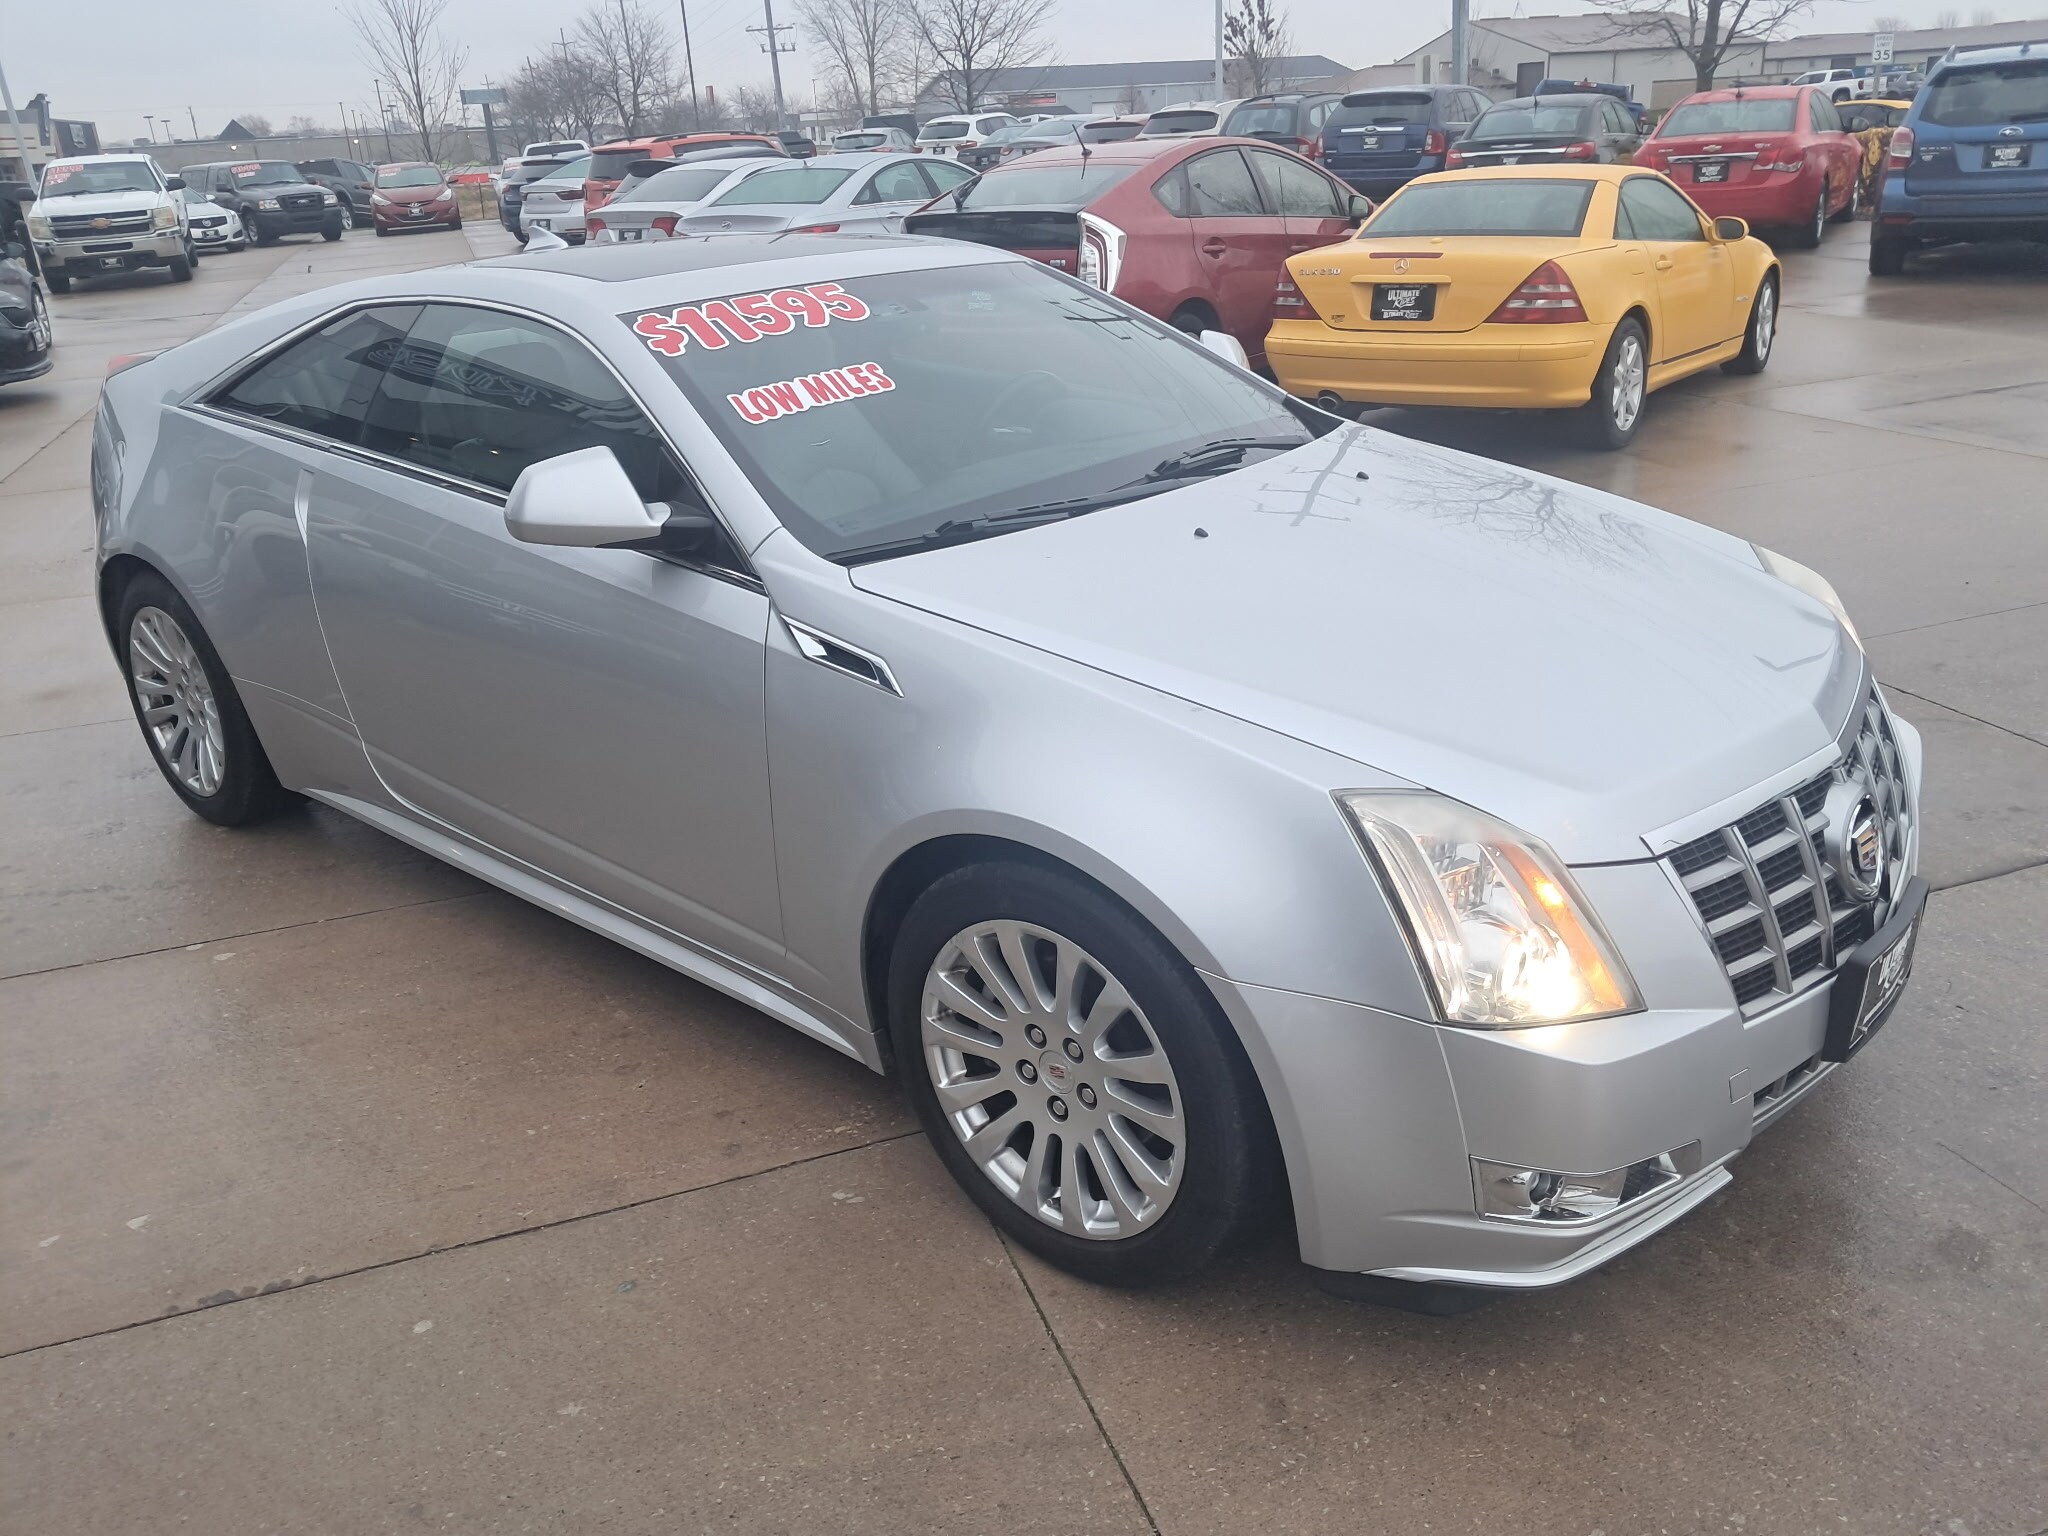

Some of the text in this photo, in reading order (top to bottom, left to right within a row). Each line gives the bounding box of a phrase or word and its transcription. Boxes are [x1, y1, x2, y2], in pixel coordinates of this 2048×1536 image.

[1873, 49, 1891, 61] 35
[1387, 289, 1421, 301] ULTIMATE
[633, 281, 871, 358] $11595
[726, 362, 896, 425] LOW MILES
